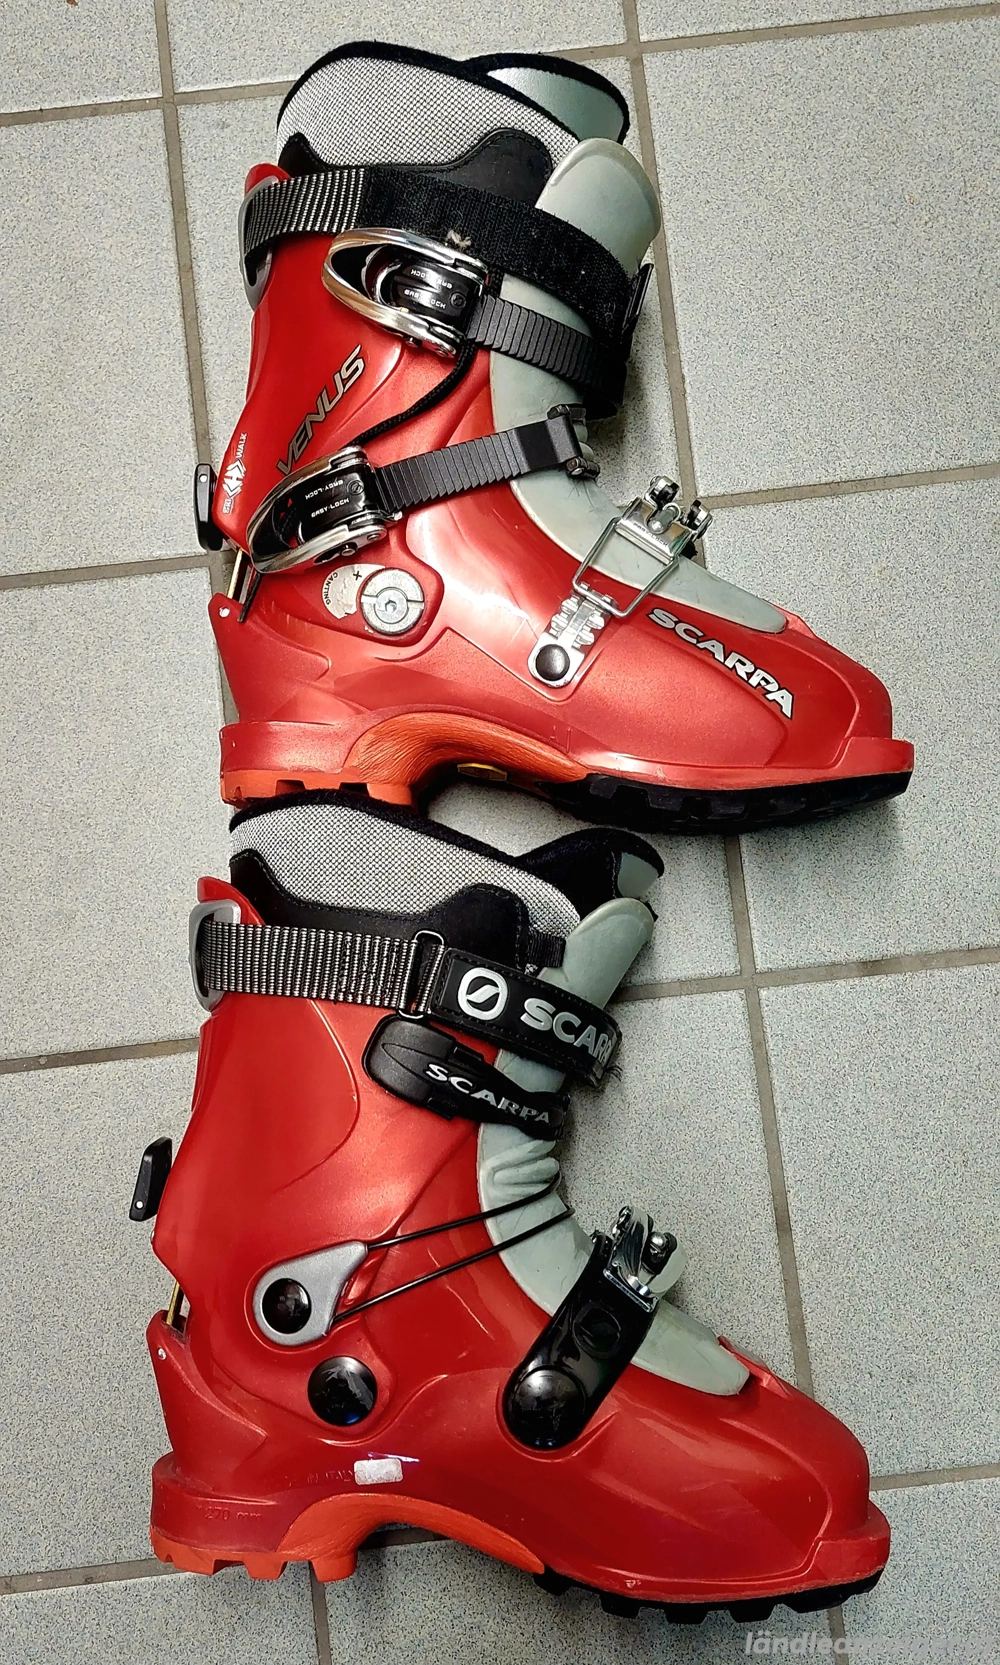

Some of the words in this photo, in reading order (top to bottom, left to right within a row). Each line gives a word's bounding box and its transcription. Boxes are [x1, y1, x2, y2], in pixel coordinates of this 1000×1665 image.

[276, 344, 365, 475] VENUS
[235, 432, 247, 459] WALK
[310, 497, 350, 518] EASY-LOCK
[323, 571, 339, 606] CANTING
[647, 607, 795, 720] SCARPA
[425, 1063, 551, 1124] SCARPA
[204, 1505, 230, 1521] 270
